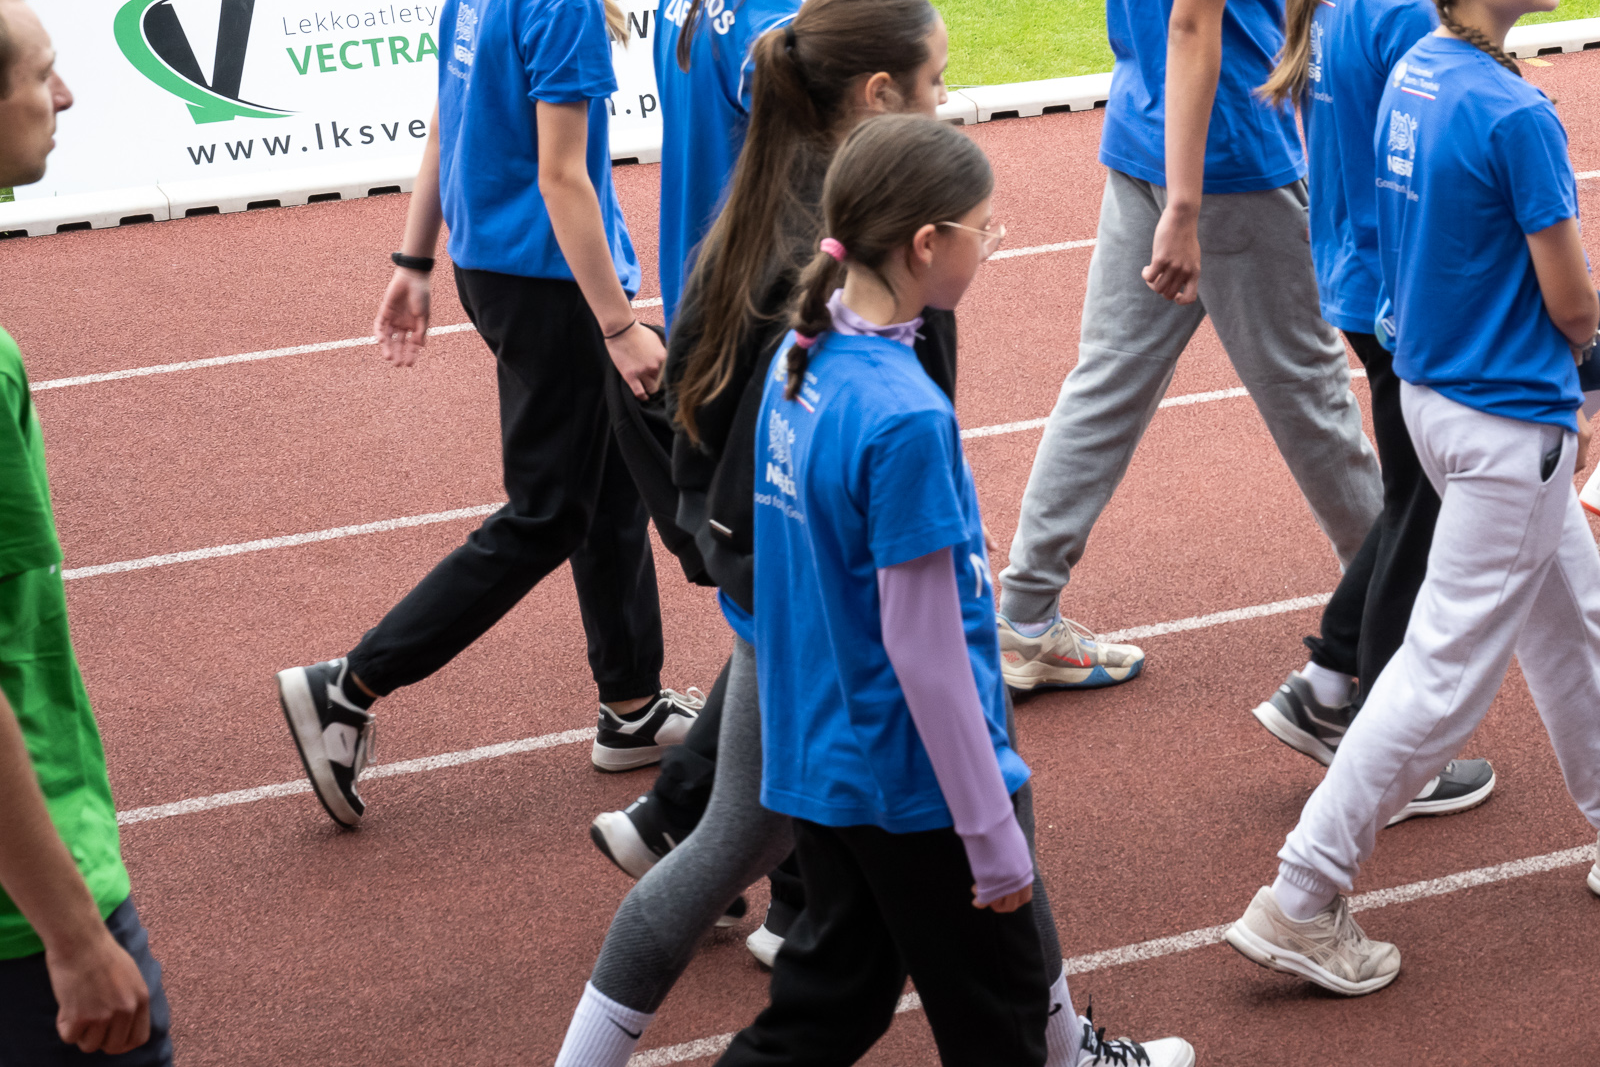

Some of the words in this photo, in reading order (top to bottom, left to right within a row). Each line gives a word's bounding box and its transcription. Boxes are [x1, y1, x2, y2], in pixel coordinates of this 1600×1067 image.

[281, 1, 438, 36] Lekkoatlety
[285, 31, 439, 76] VECTRA
[186, 118, 428, 167] www.lksve
